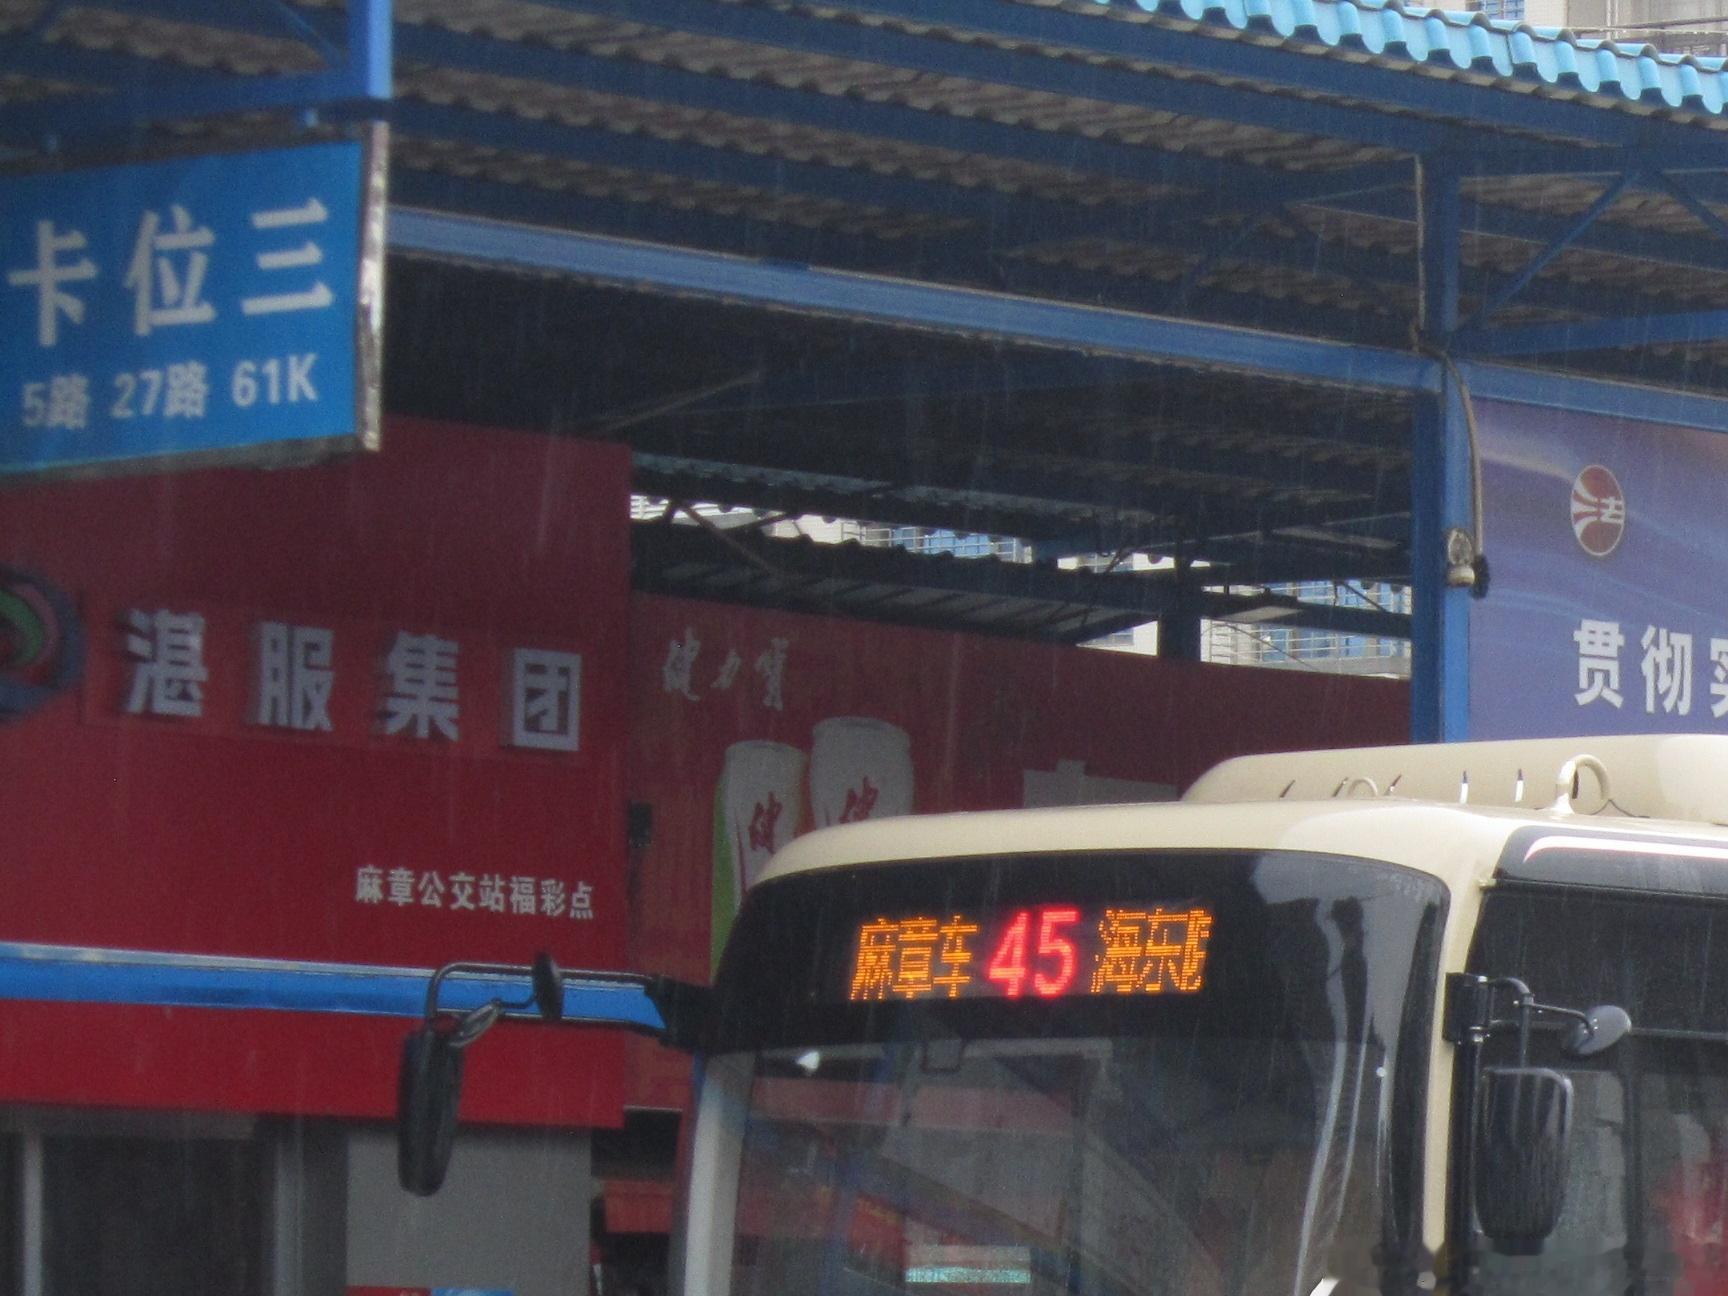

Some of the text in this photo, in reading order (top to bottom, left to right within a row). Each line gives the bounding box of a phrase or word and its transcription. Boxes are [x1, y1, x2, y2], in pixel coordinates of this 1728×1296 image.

[8, 197, 333, 347] 卡位三
[22, 352, 321, 430] 5路 27路 61K
[126, 608, 583, 752] 湛服集团
[355, 864, 594, 920] 麻章公交站福彩点
[850, 914, 980, 1002] 麻章车
[986, 907, 1082, 1000] 45
